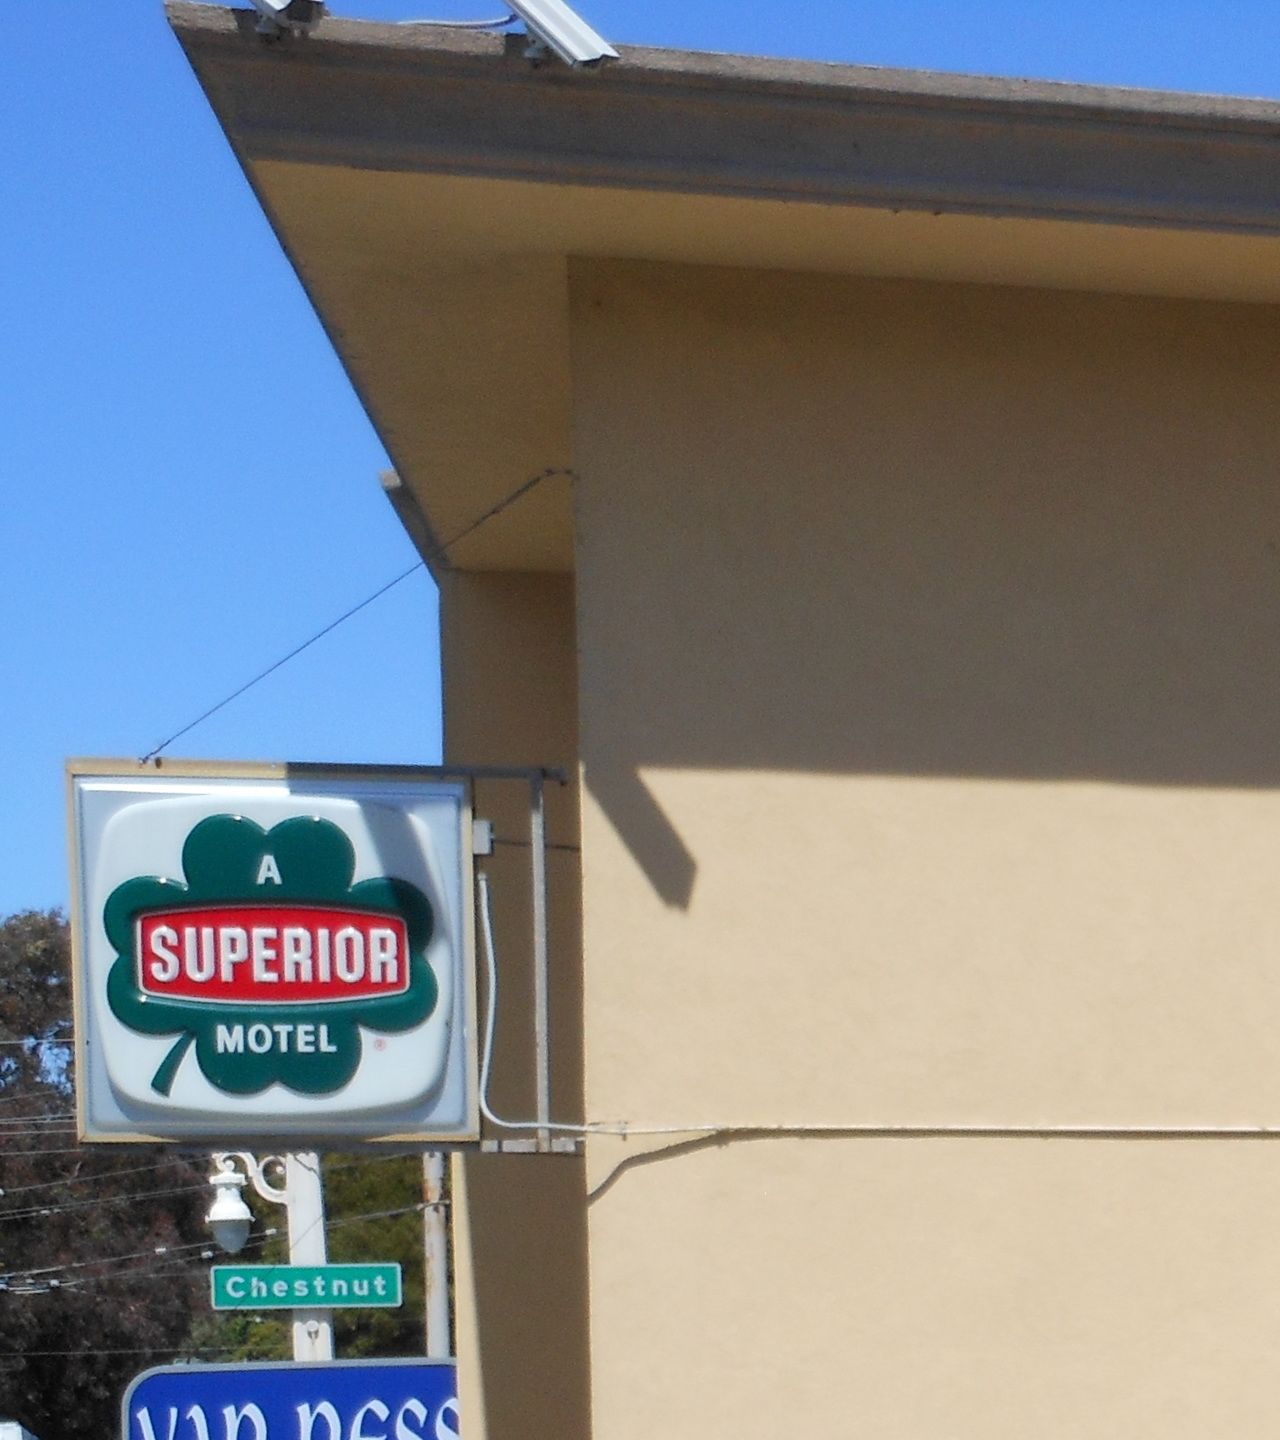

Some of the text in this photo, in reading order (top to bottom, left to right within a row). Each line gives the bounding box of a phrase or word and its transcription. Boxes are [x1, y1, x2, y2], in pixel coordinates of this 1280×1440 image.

[256, 855, 282, 885] A
[149, 927, 399, 984] SUPERIOR
[216, 1023, 337, 1053] MOTEL
[225, 1275, 388, 1299] Chestnut
